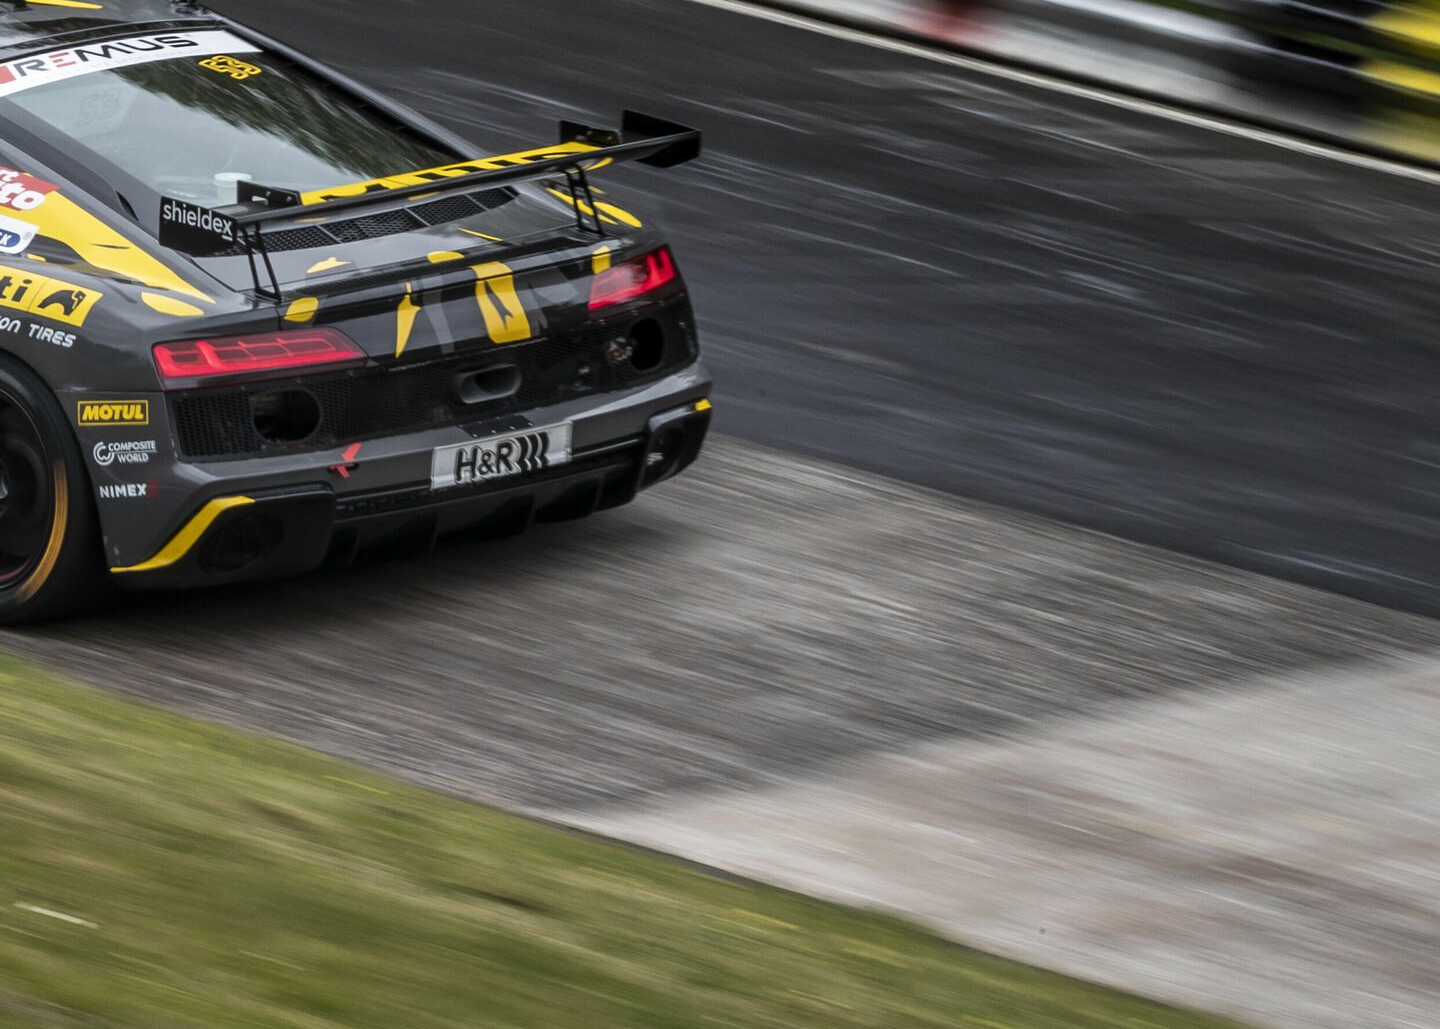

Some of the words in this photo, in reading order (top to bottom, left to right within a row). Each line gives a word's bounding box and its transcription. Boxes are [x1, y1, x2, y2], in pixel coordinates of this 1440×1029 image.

[13, 35, 200, 78] REMUS
[162, 202, 233, 236] shieldex
[29, 323, 78, 349] TIRES
[82, 404, 145, 422] MOTUL
[108, 440, 157, 452] COMPOSITE
[117, 453, 150, 464] WORLD
[455, 441, 513, 483] H&R
[99, 483, 148, 499] NIMEX
